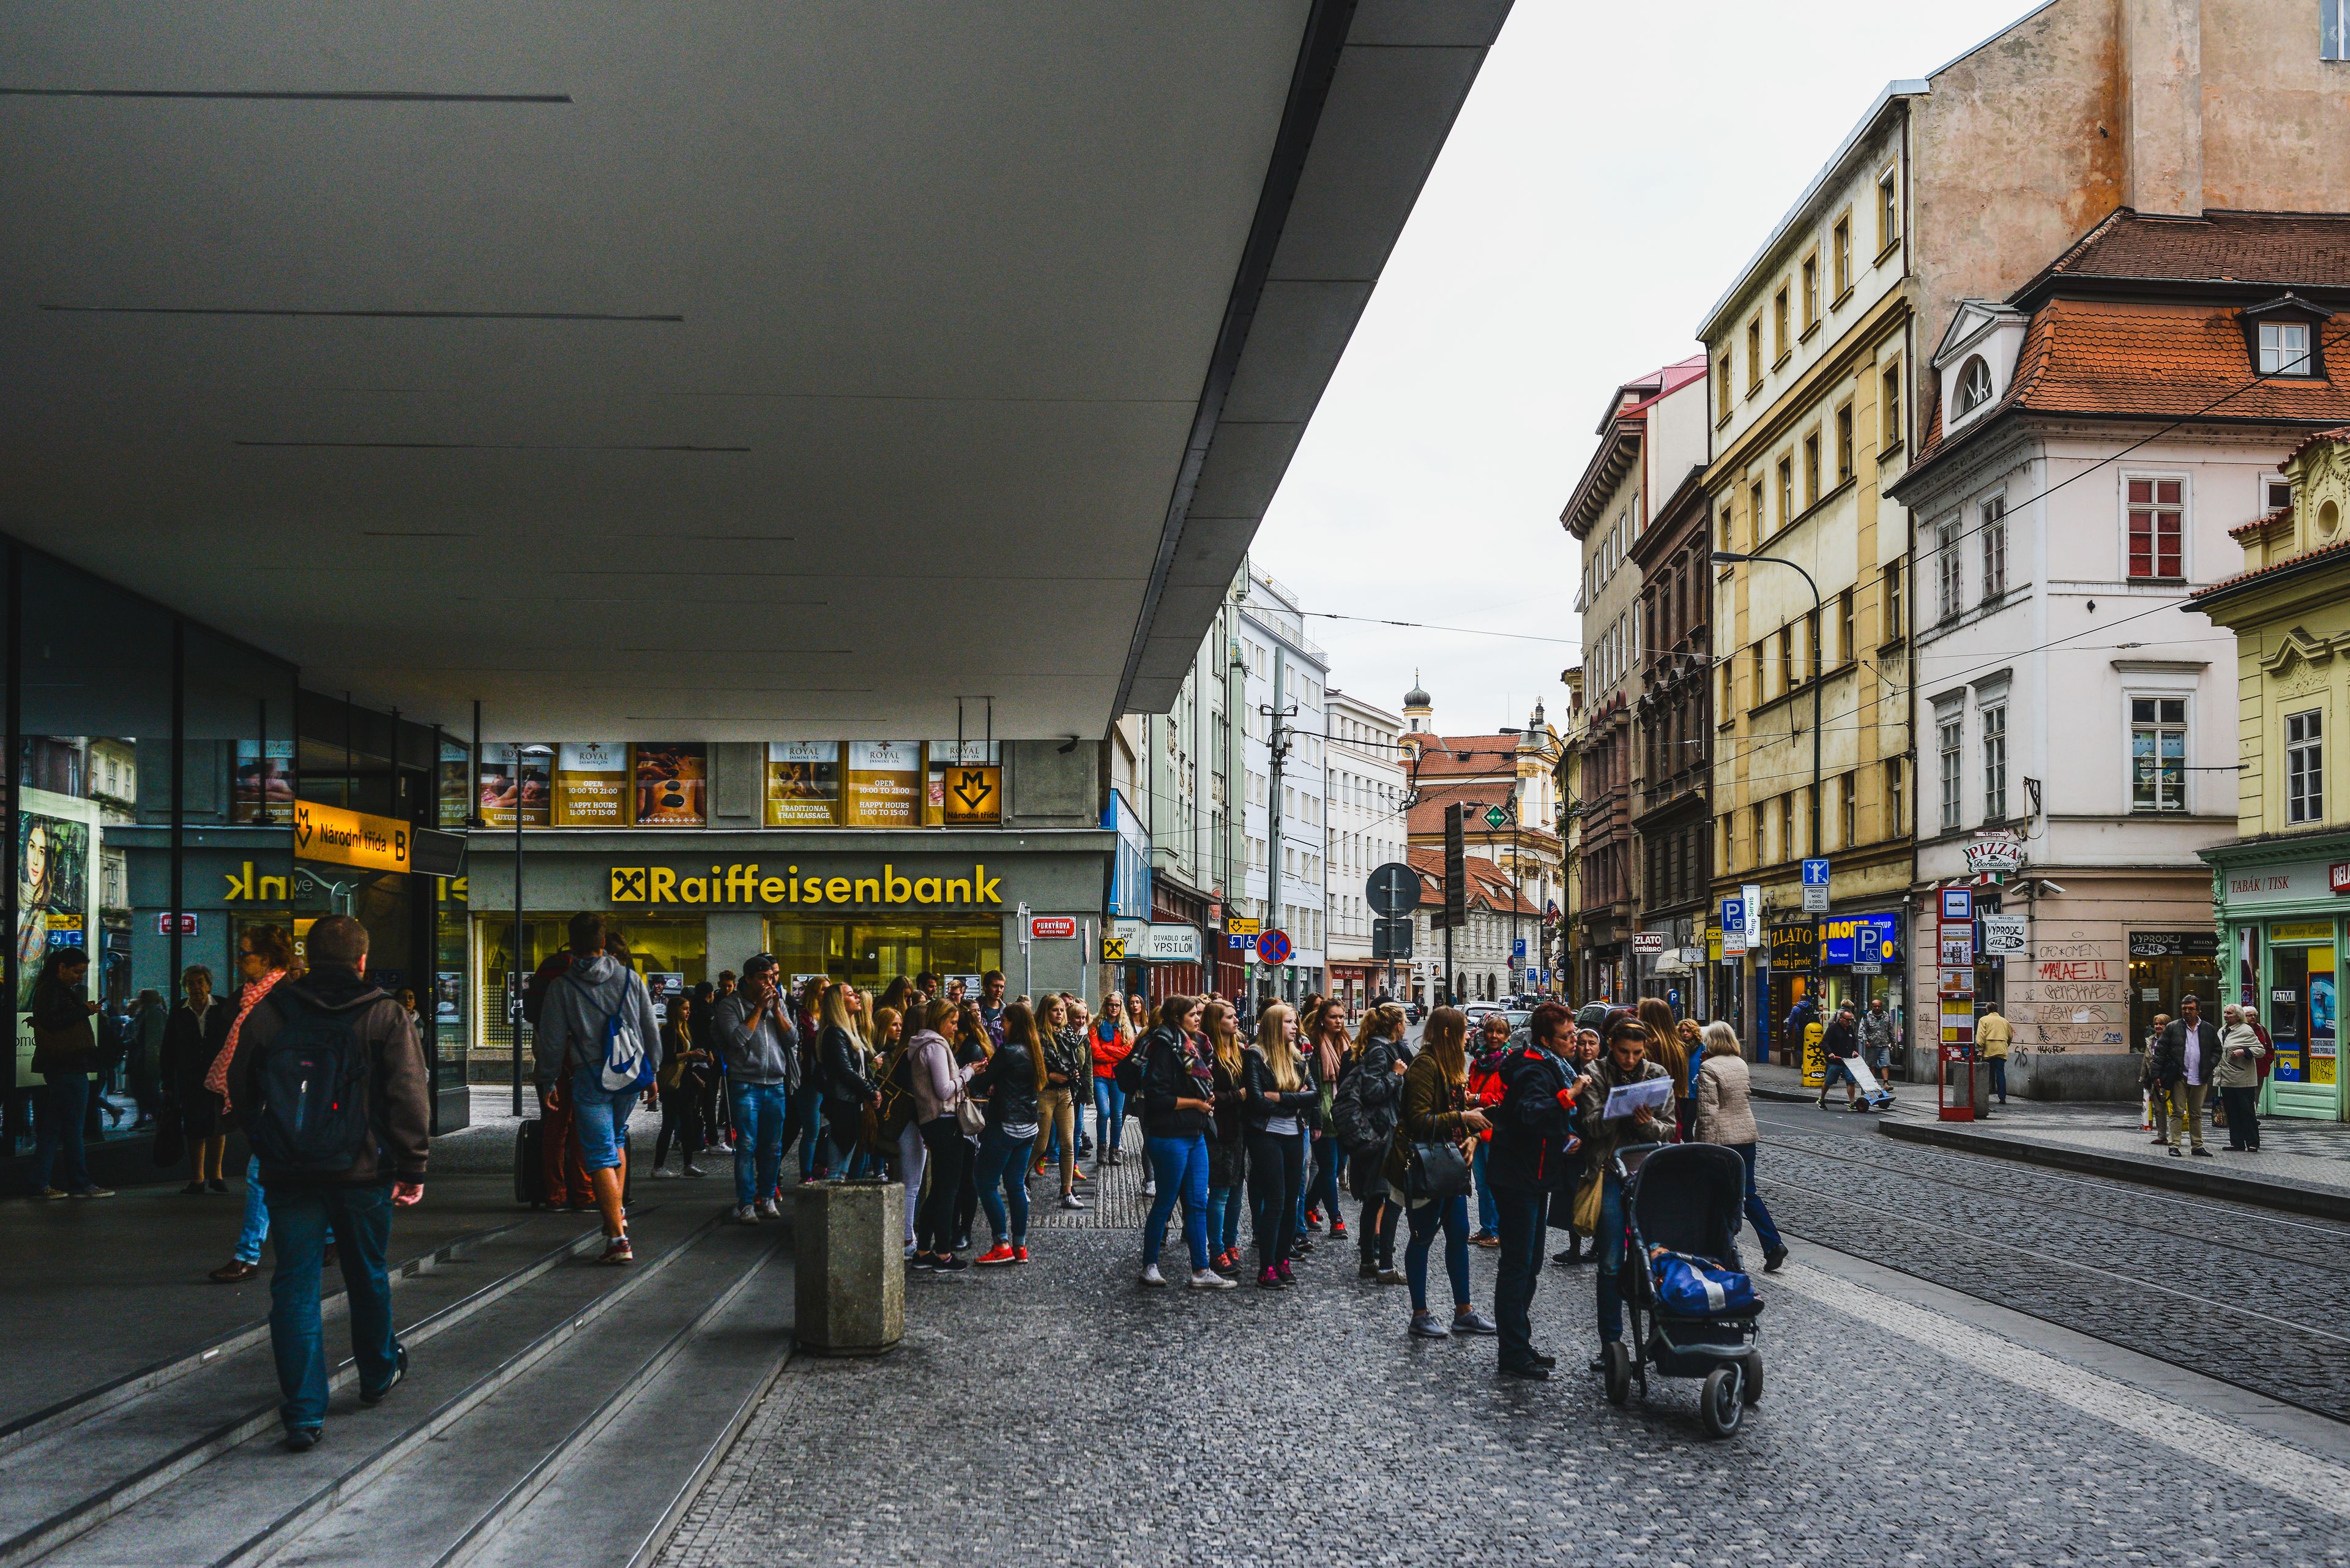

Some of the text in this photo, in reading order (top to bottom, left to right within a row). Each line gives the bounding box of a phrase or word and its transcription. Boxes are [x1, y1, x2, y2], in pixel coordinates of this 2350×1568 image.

[319, 823, 406, 862] Národní třída B
[1967, 842, 2018, 861] PIZZA
[651, 864, 1004, 903] Raiffeisenbank
[2231, 875, 2261, 894] TABÁK
[2267, 875, 2290, 890] TISK
[1726, 903, 1740, 922] P
[1037, 920, 1070, 930] PURKYŇOVA
[1987, 923, 2024, 936] VÝPRODEJ
[1635, 935, 1662, 944] ZLATO
[1772, 927, 1812, 947] ZLATO
[1861, 930, 1878, 952] P
[1990, 938, 2002, 946] JIŽ
[1154, 943, 1193, 953] YPSILON
[1515, 941, 1523, 952] P
[1794, 956, 1812, 969] prode
[2275, 991, 2292, 1001] ATM
